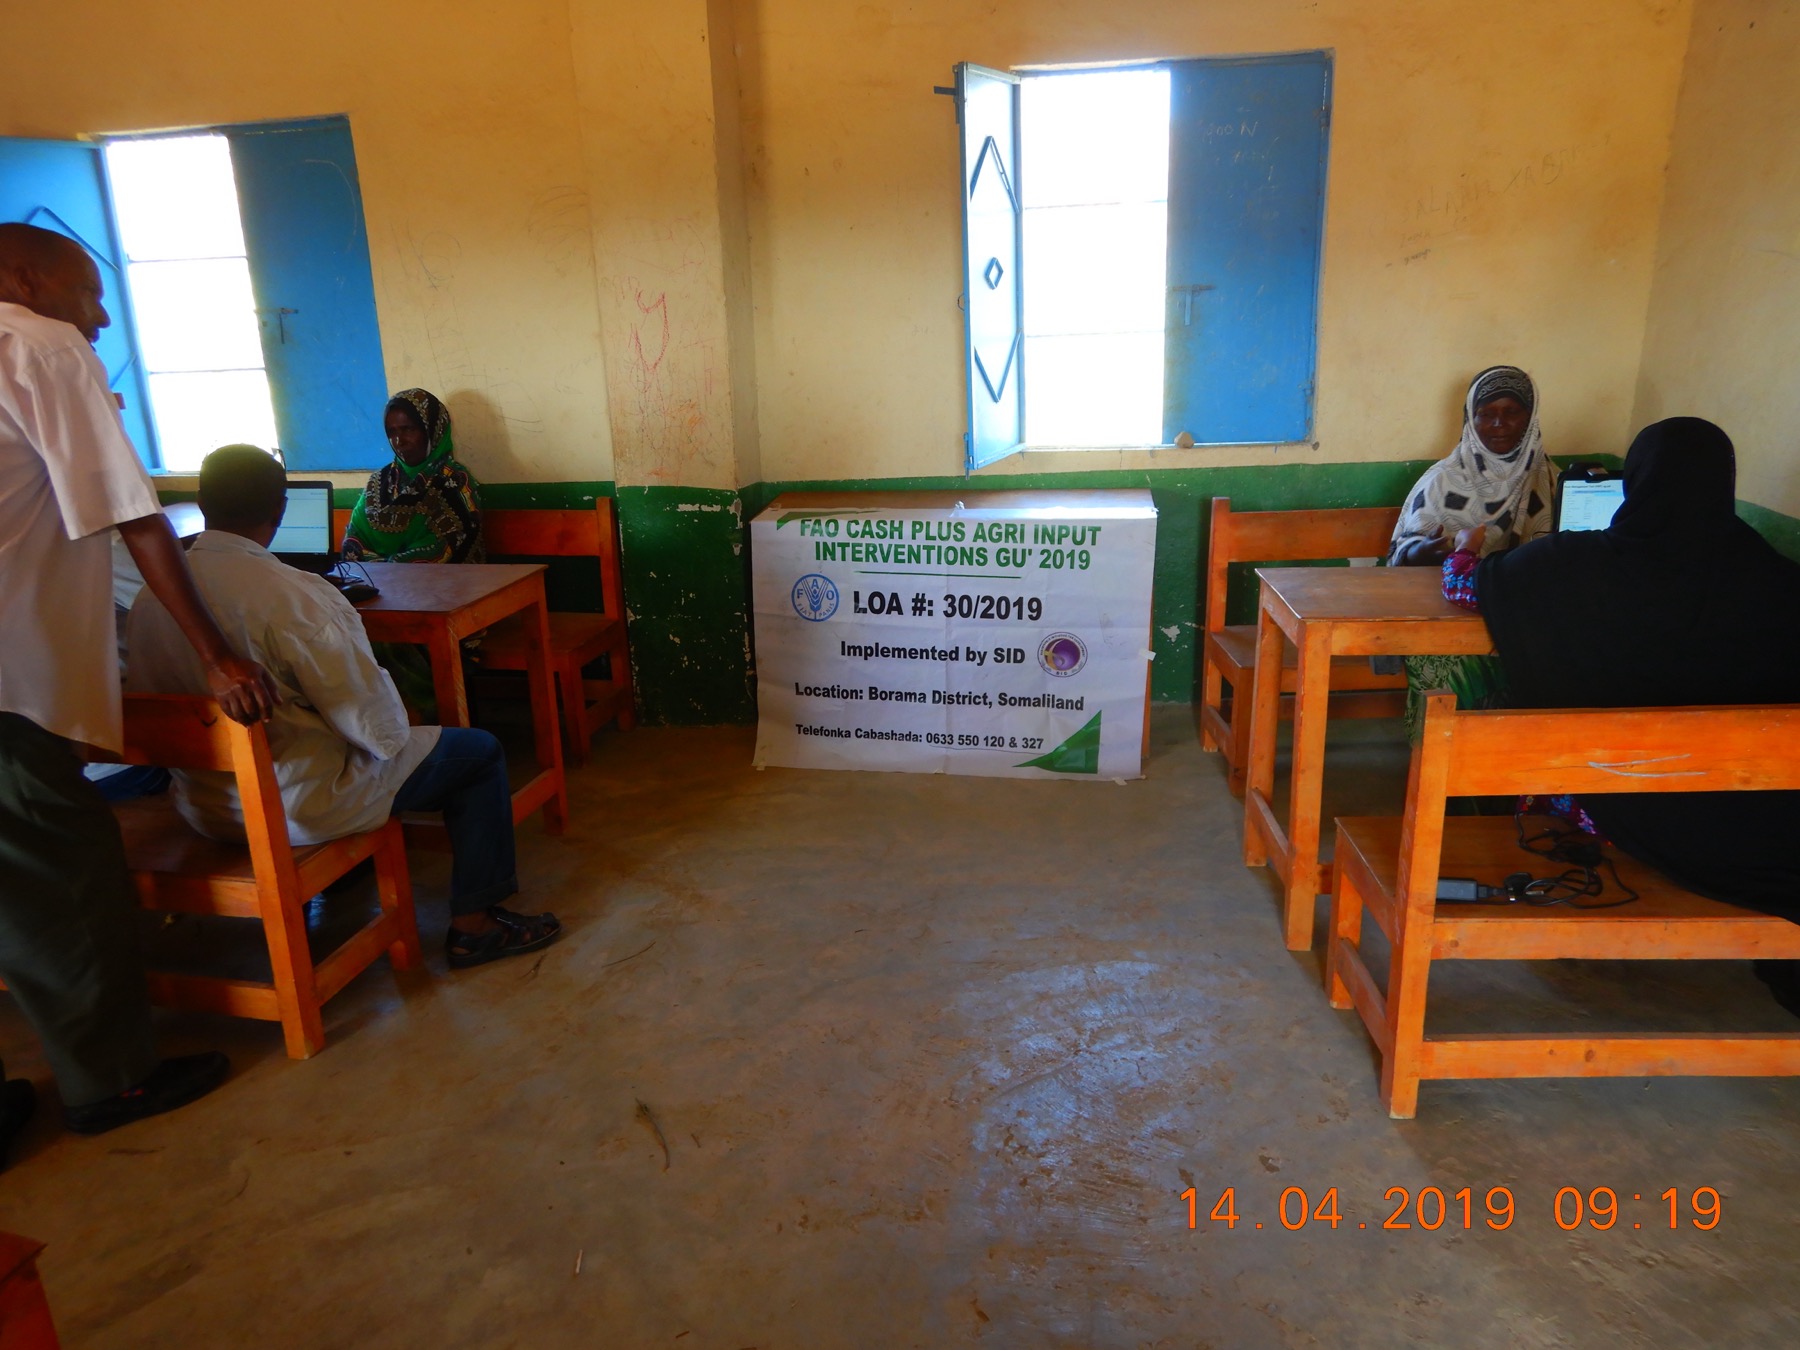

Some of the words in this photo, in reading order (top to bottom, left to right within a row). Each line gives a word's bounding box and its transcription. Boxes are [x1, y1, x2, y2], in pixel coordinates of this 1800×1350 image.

[800, 518, 839, 538] FAO
[846, 519, 904, 540] CASH
[912, 520, 966, 542] PLUS
[972, 522, 1026, 544] AGRI
[1033, 524, 1102, 546] INPUT
[815, 541, 988, 567] INTERVENTIONS
[995, 547, 1032, 568] GU'
[1039, 549, 1091, 570] 2019
[853, 590, 904, 615] LOA
[911, 592, 933, 617] #:
[943, 594, 1042, 621] 30/2019
[841, 641, 960, 662] Implemented
[965, 646, 987, 666] by
[993, 647, 1026, 664] SID
[795, 682, 864, 700] Location:
[869, 686, 926, 704] Borama
[932, 690, 993, 709] District,
[998, 692, 1084, 711] Somaliland
[795, 723, 851, 738] Telefonka
[855, 727, 922, 743] Cabashada:
[926, 732, 954, 745] 0633
[957, 734, 979, 747] 550
[983, 735, 1005, 748] 120
[1008, 736, 1018, 748] &
[1022, 737, 1044, 749] 327
